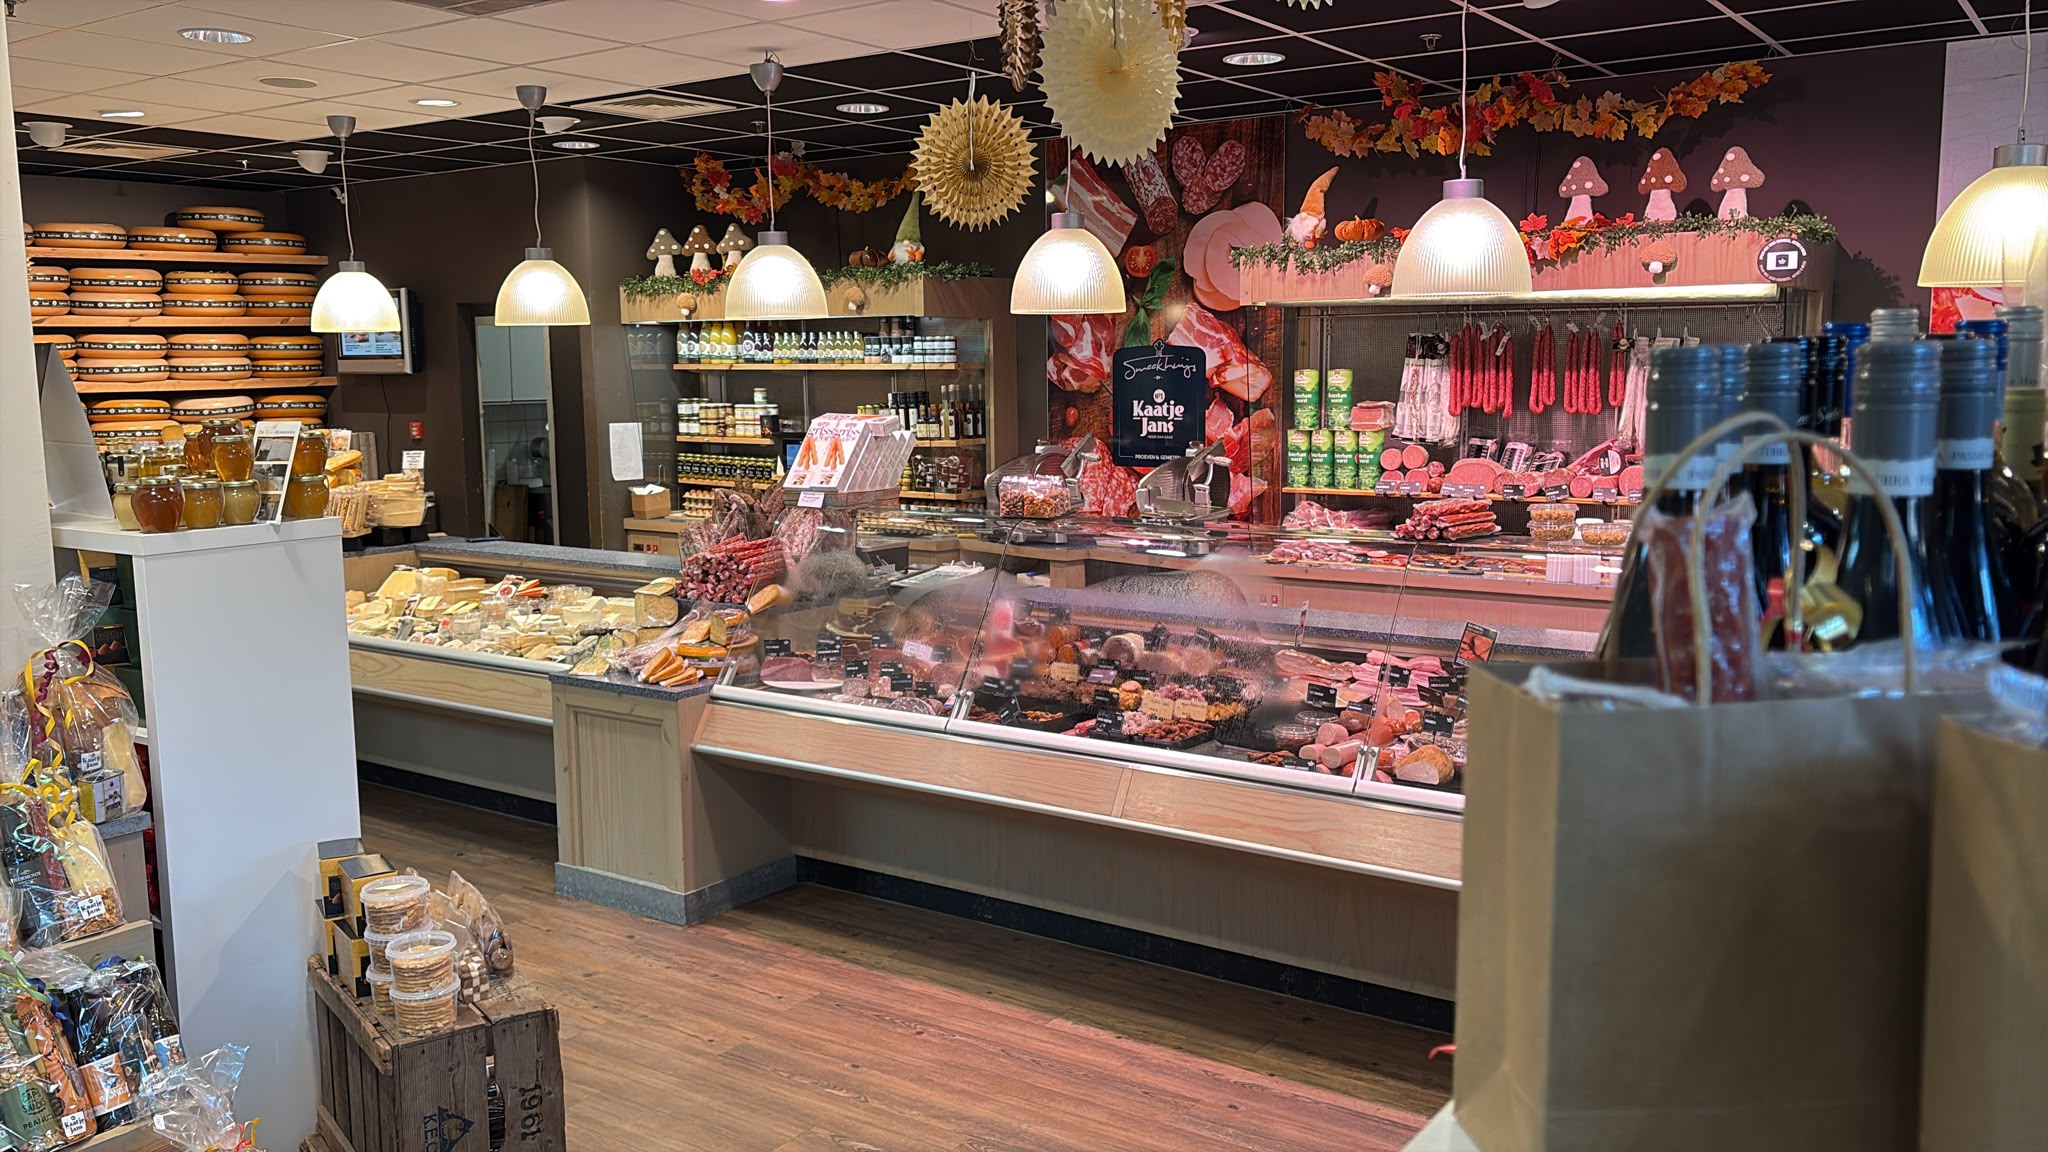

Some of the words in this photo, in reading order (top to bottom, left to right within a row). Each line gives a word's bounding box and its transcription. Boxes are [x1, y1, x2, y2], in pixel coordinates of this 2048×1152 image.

[1132, 400, 1185, 420] Kaatje
[1140, 417, 1174, 437] Jans
[80, 900, 103, 911] Kaatje
[86, 907, 101, 915] Jans
[519, 1083, 543, 1141] 1961
[64, 1117, 85, 1129] Kaatje
[70, 1124, 83, 1134] Jans
